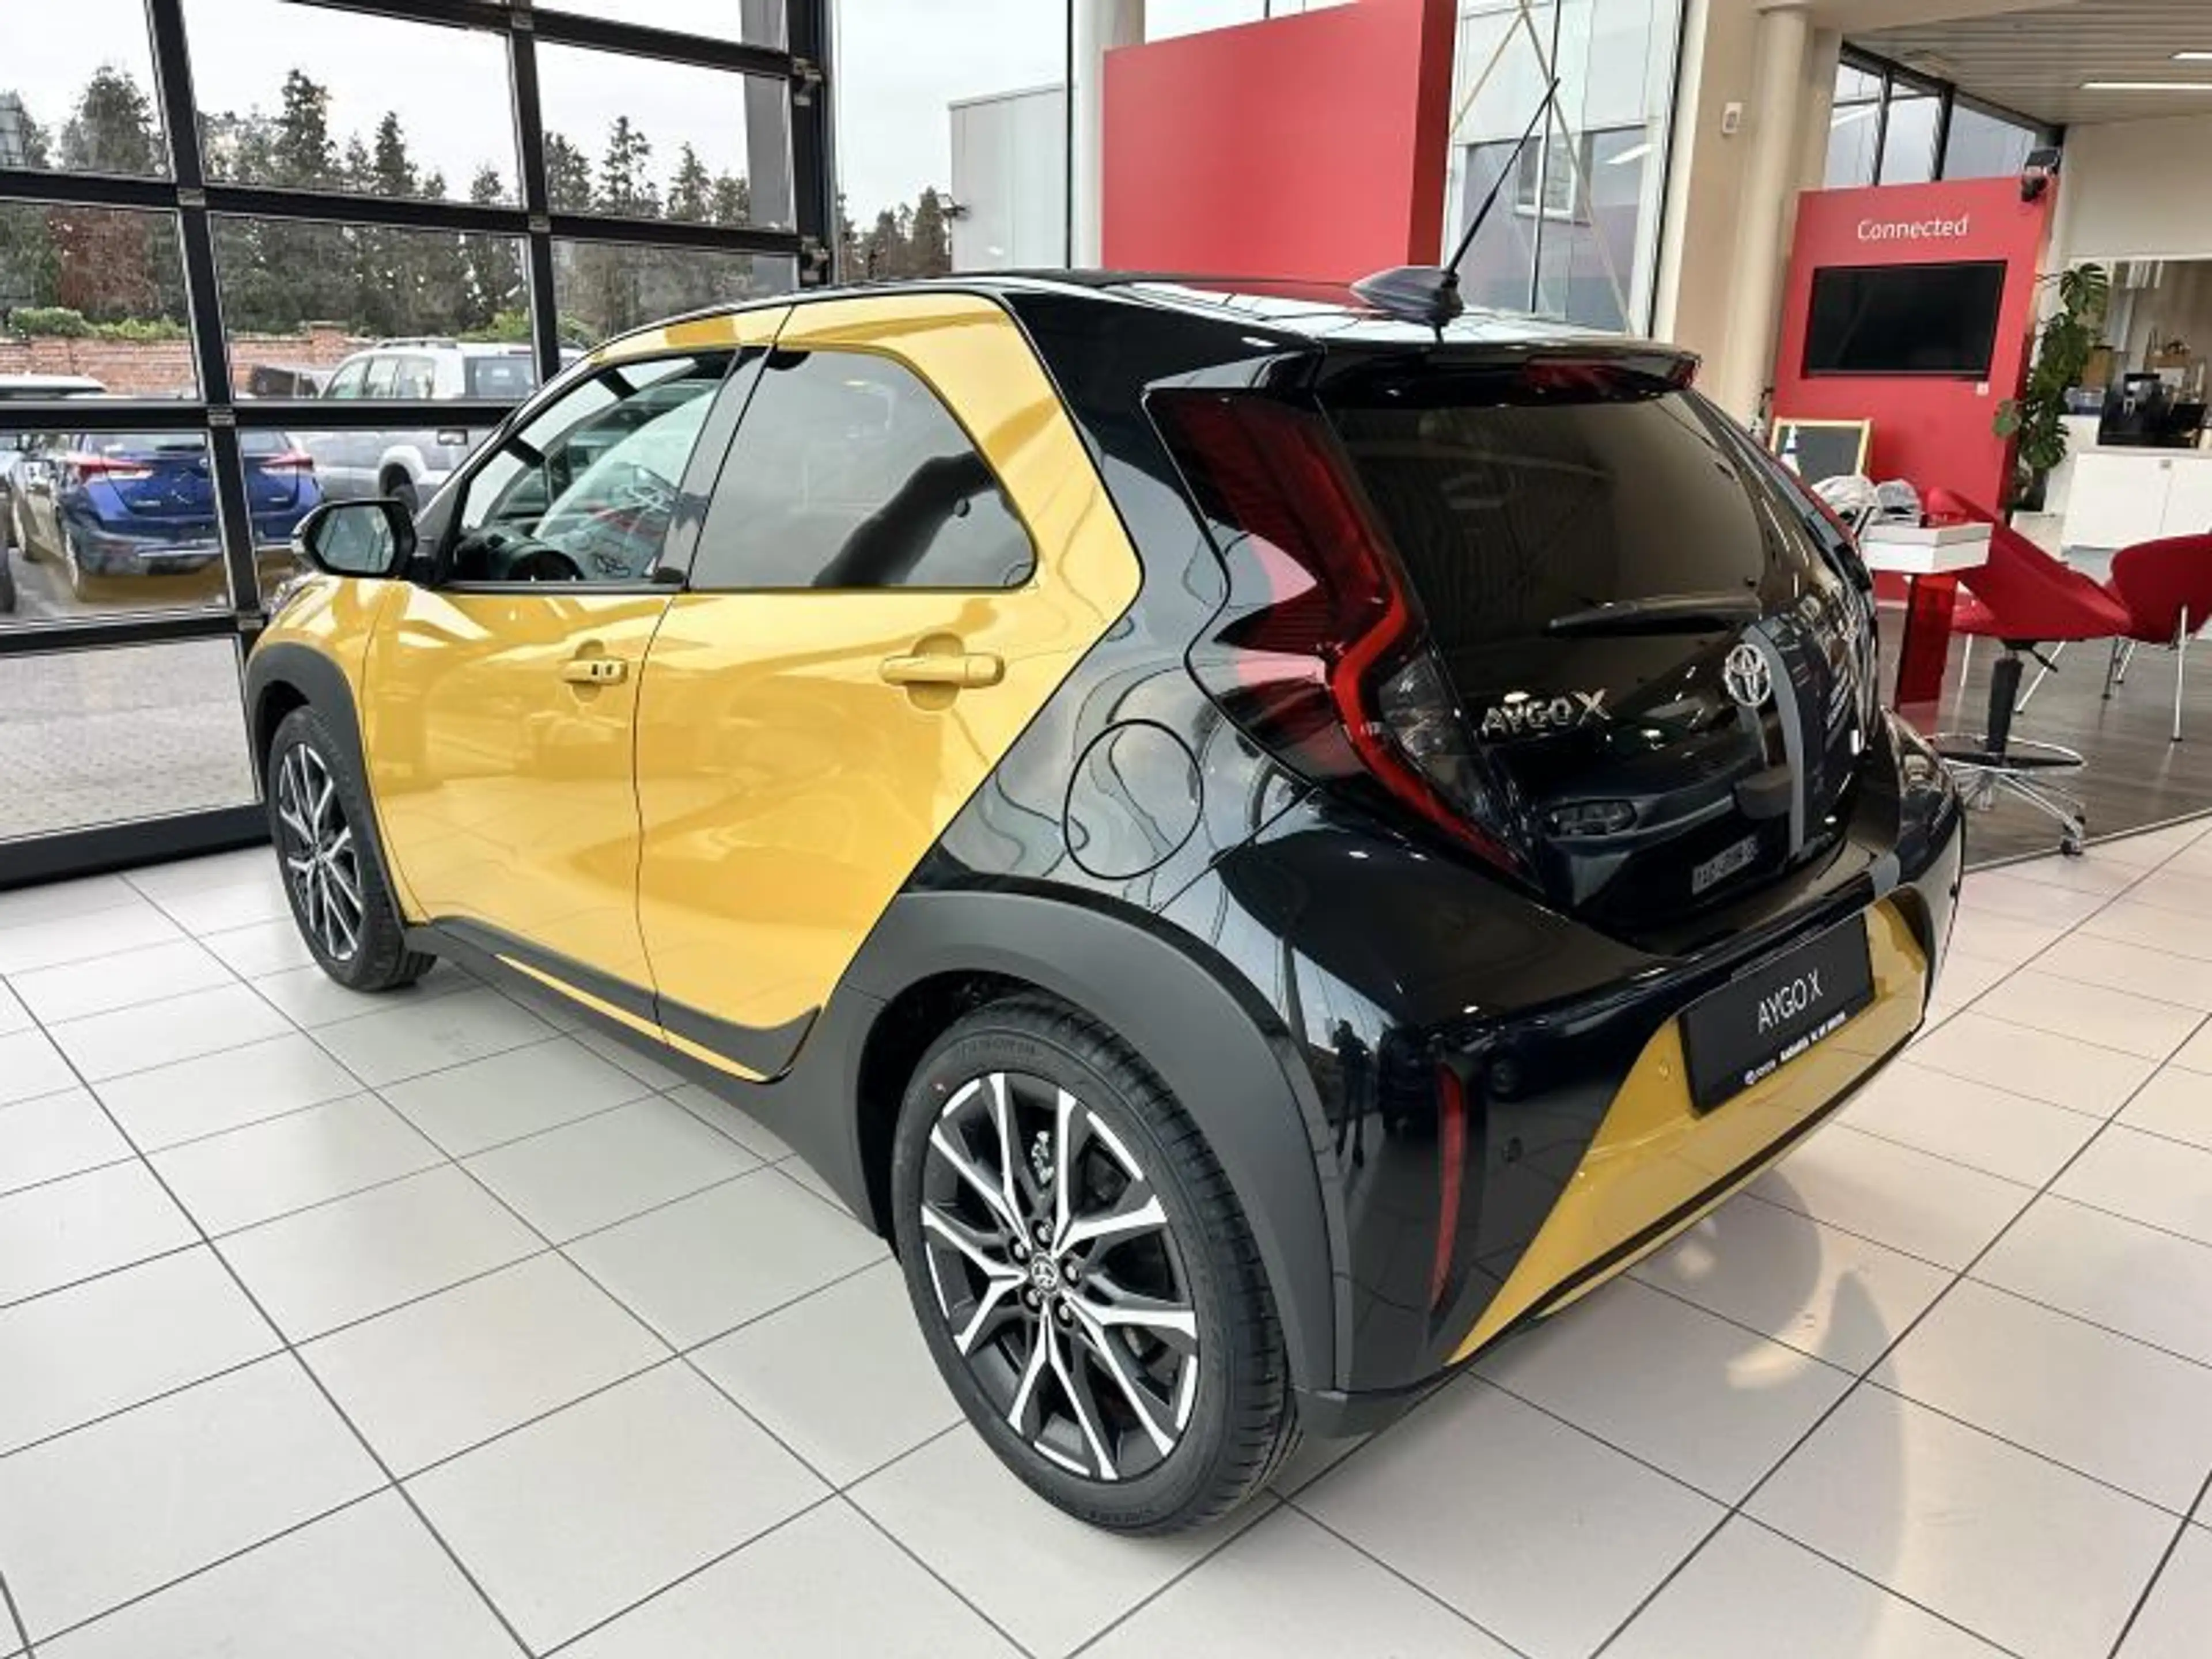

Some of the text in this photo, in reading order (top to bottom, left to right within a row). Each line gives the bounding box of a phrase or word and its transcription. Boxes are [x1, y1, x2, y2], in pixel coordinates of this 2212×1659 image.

[1858, 214, 1969, 241] Connected
[1481, 688, 1612, 737] AYGO X
[1758, 968, 1823, 1034] AYGO X
